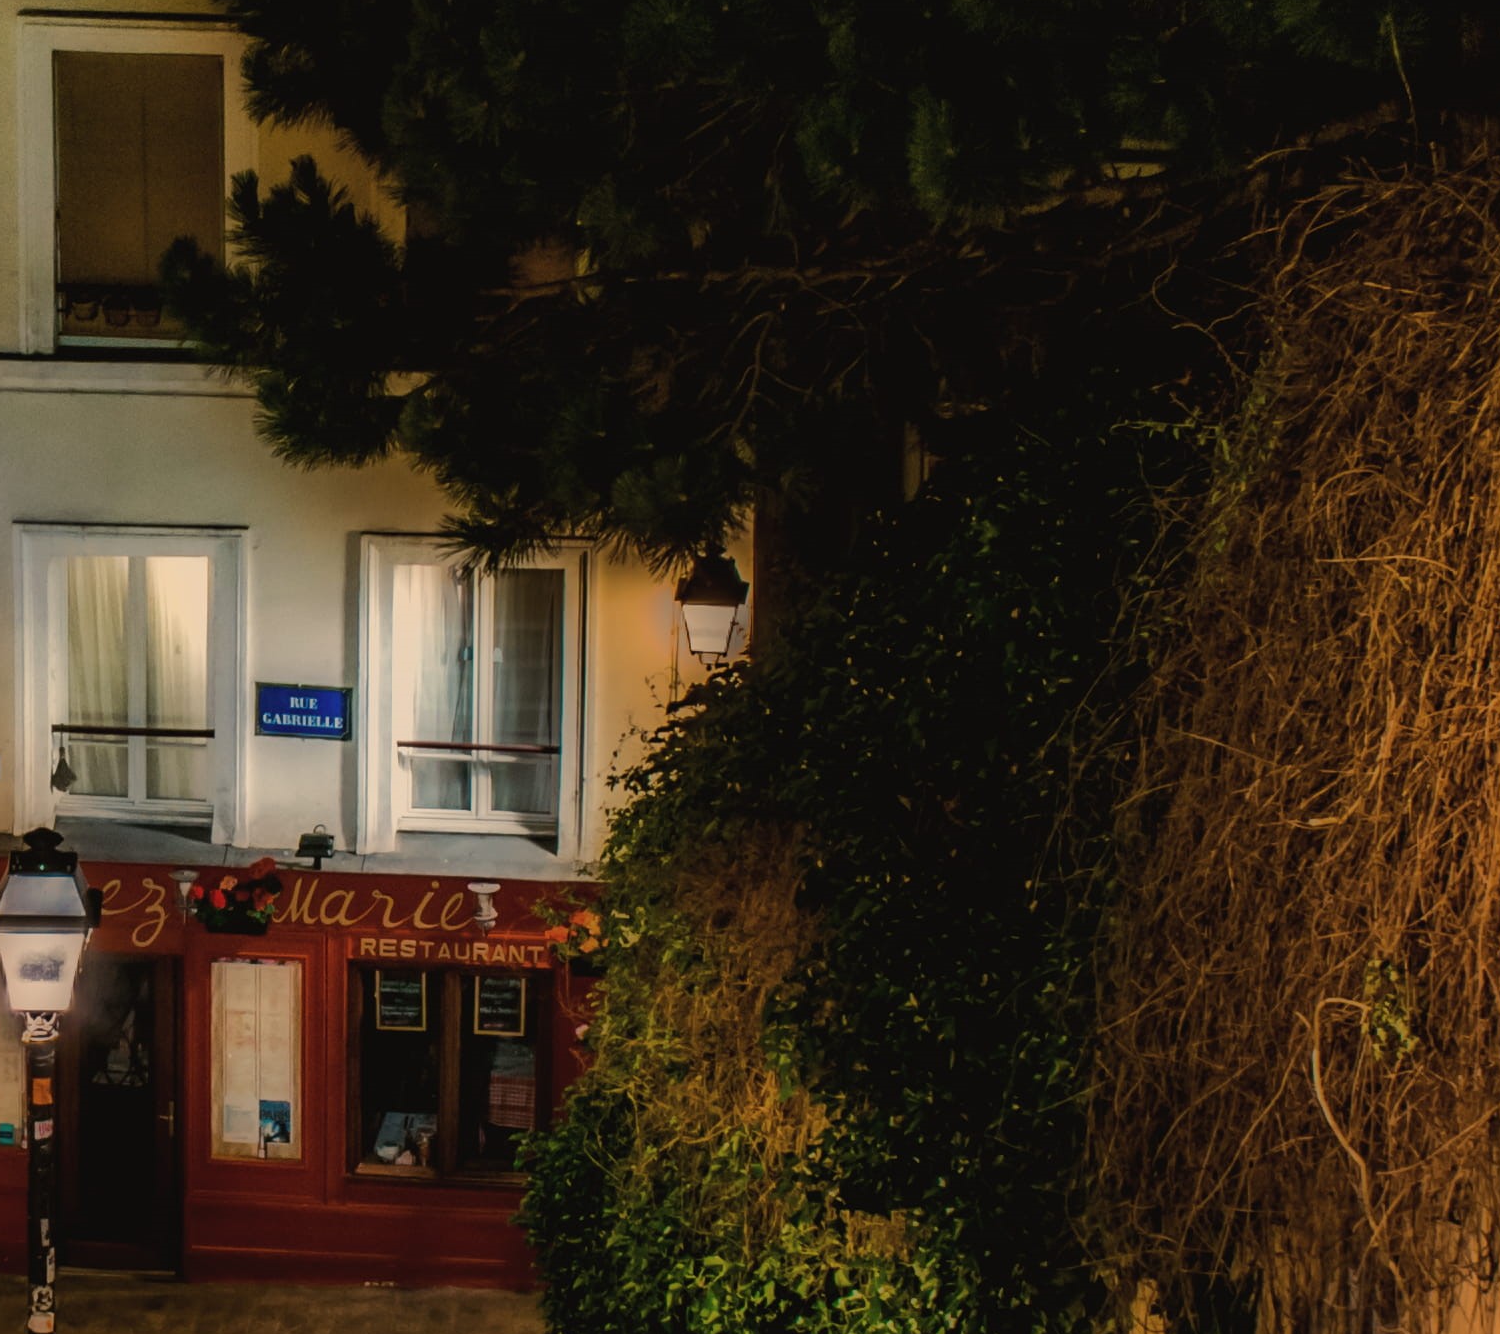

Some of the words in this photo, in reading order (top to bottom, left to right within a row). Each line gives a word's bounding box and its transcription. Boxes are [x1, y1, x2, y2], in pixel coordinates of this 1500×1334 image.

[289, 696, 318, 710] RUE
[262, 712, 344, 729] GABRIELLE
[271, 877, 476, 931] Marie
[359, 937, 545, 964] RESTAURANT
